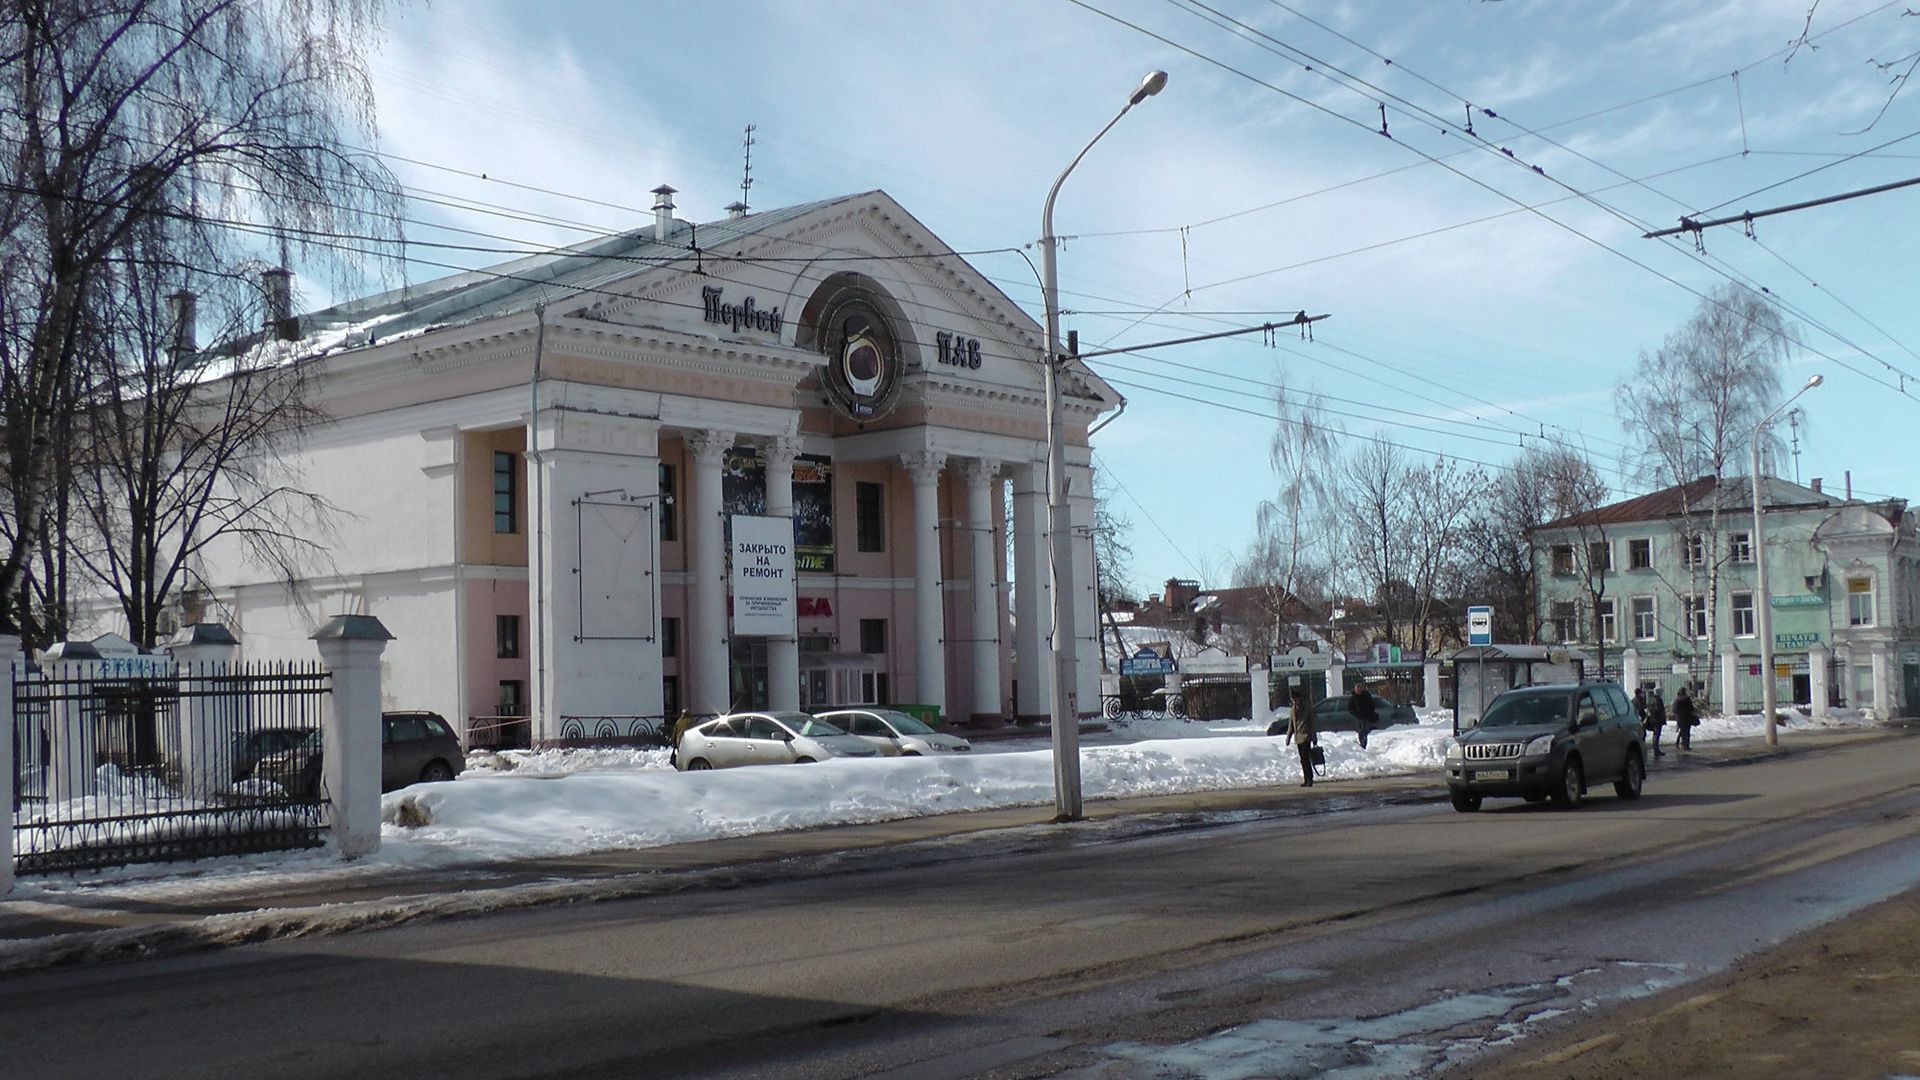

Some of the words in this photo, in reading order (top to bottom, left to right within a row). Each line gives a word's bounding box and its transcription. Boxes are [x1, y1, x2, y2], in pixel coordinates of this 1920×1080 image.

[702, 285, 782, 334] Первый
[936, 331, 982, 370] ПАБ
[739, 542, 786, 555] ЗАКРЫТО
[756, 555, 770, 566] НА
[743, 567, 784, 578] РЕМОНТ
